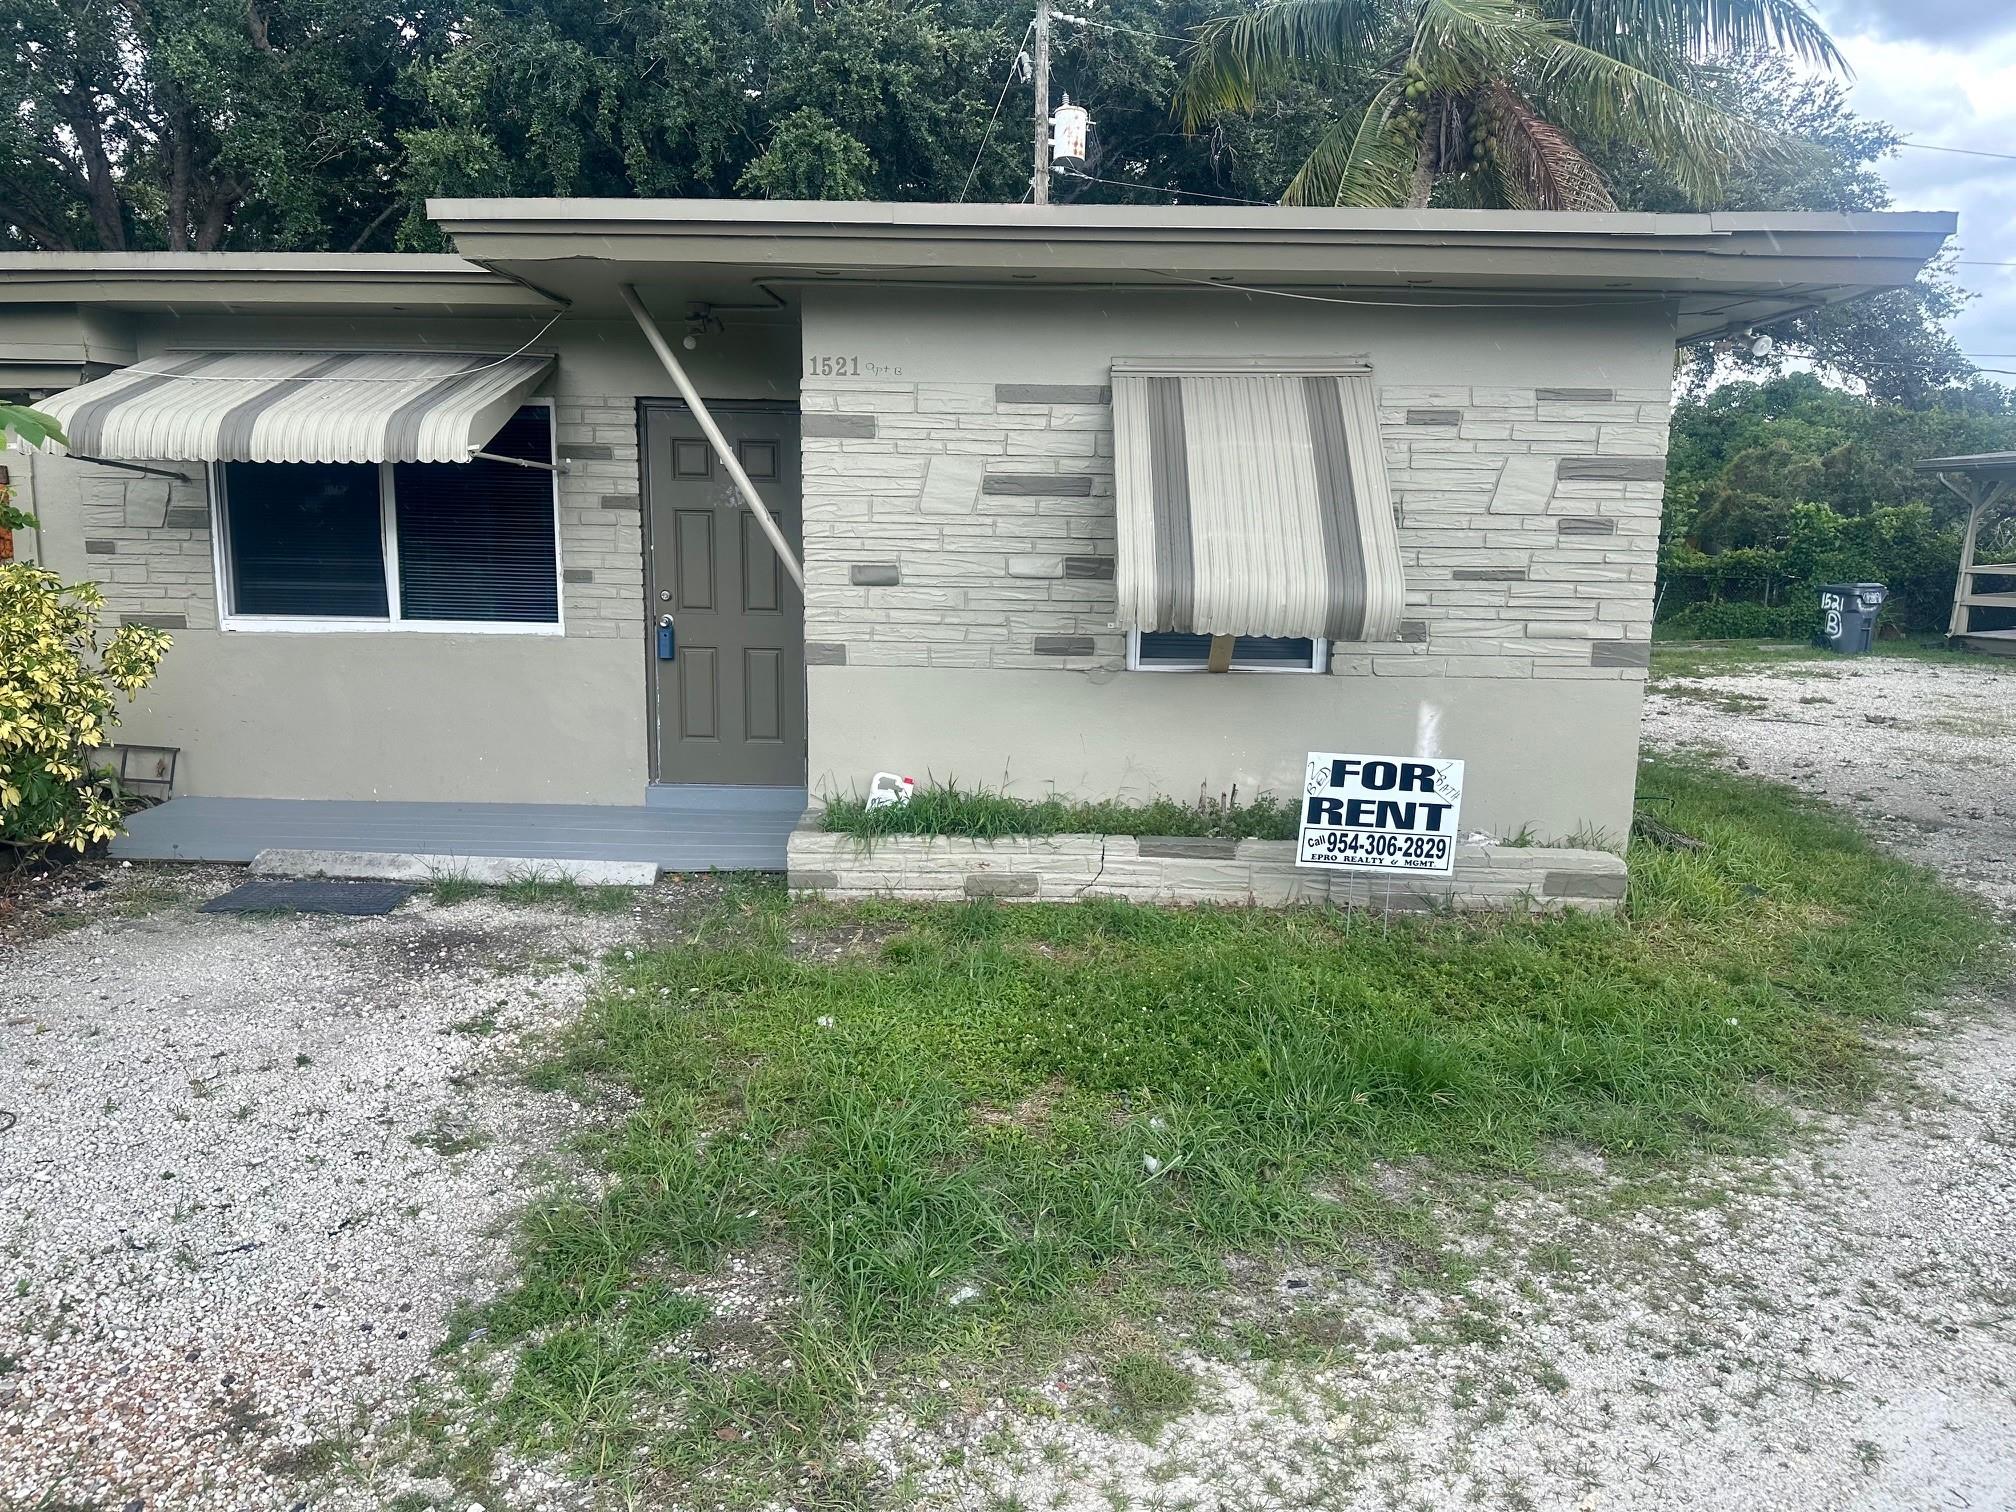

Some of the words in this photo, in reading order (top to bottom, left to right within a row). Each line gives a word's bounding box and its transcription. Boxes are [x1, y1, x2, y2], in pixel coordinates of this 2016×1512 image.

[809, 355, 861, 376] 1521
[1821, 592, 1844, 612] 1521
[1826, 613, 1839, 634] B
[1307, 761, 1321, 780] 2
[1307, 767, 1331, 795] BED
[1330, 759, 1436, 793] FOR
[1435, 769, 1461, 801] BATH
[1306, 796, 1452, 832] RENT
[1308, 834, 1326, 848] Call
[1326, 832, 1447, 860] 954-306-2829
[1311, 853, 1338, 861] EPRO
[1343, 855, 1385, 865] REALTY
